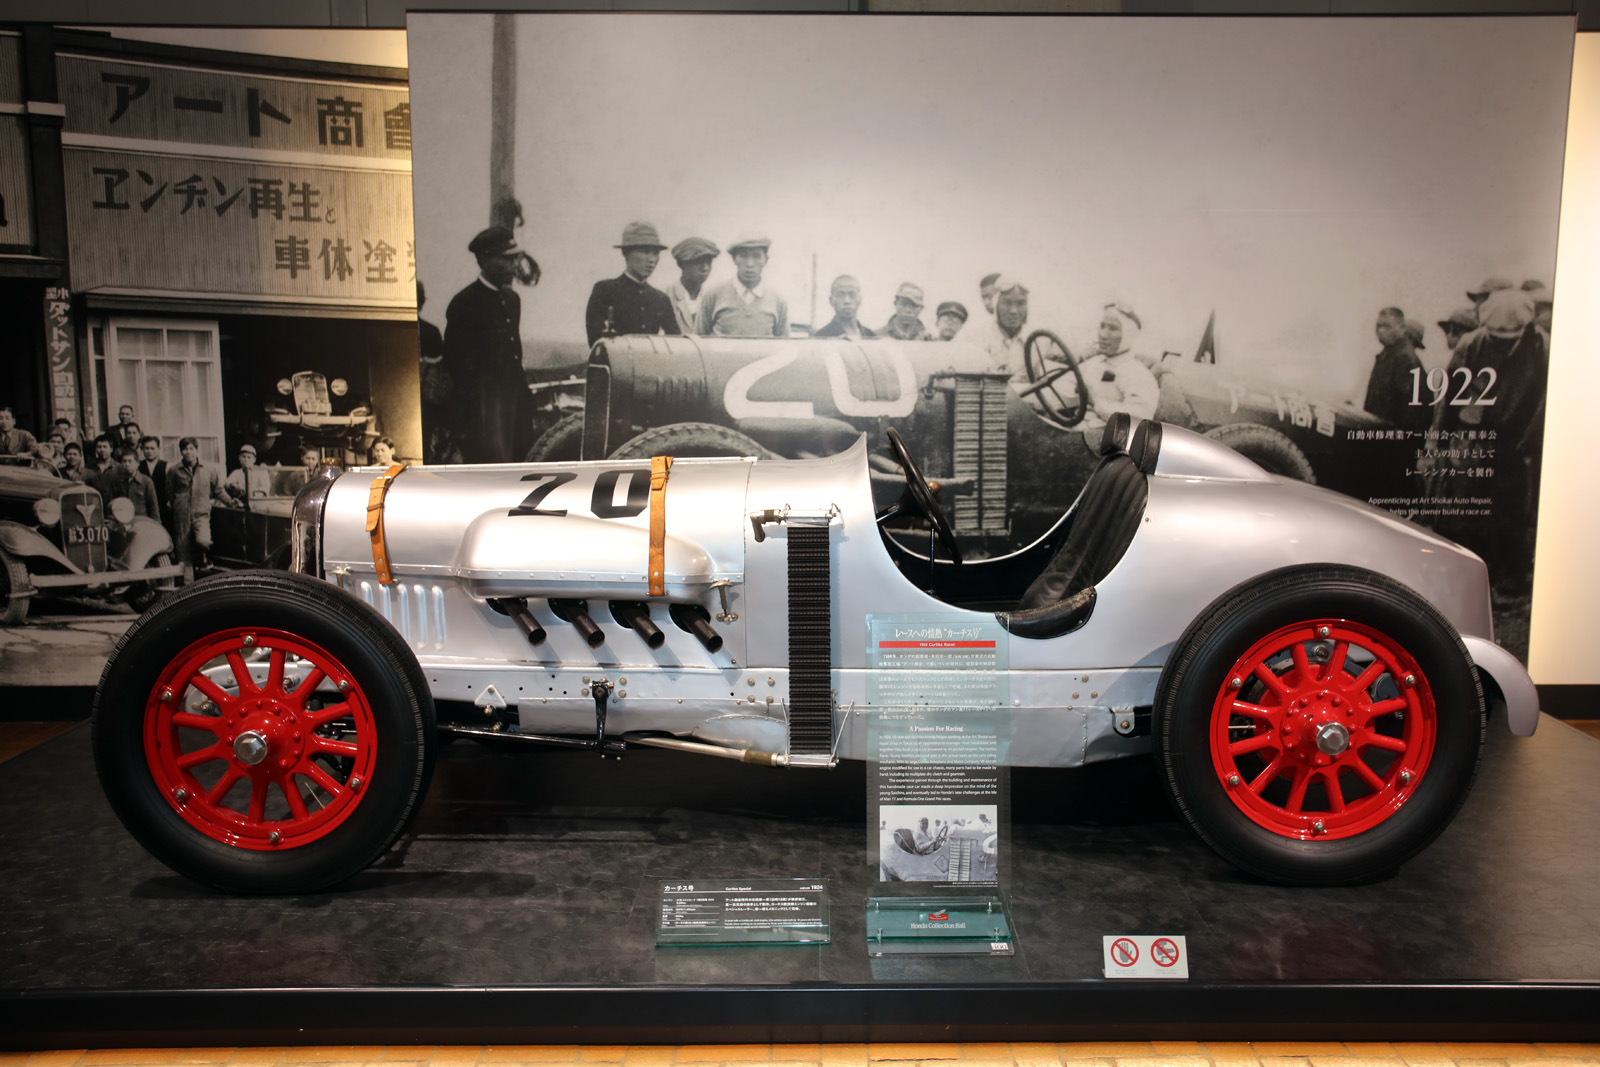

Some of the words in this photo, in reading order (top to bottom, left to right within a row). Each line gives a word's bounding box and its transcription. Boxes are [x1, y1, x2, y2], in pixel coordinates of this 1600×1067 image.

[274, 235, 415, 284] 車体塗
[725, 346, 918, 419] 20
[1408, 367, 1497, 407] 1922
[1415, 449, 1496, 459] 主人らの助手として
[1405, 467, 1495, 478] レーシングカーを製作
[508, 470, 653, 519] 20
[1368, 498, 1410, 506] Apprenticing
[1470, 498, 1493, 506] Repair,
[1389, 508, 1407, 517] helps
